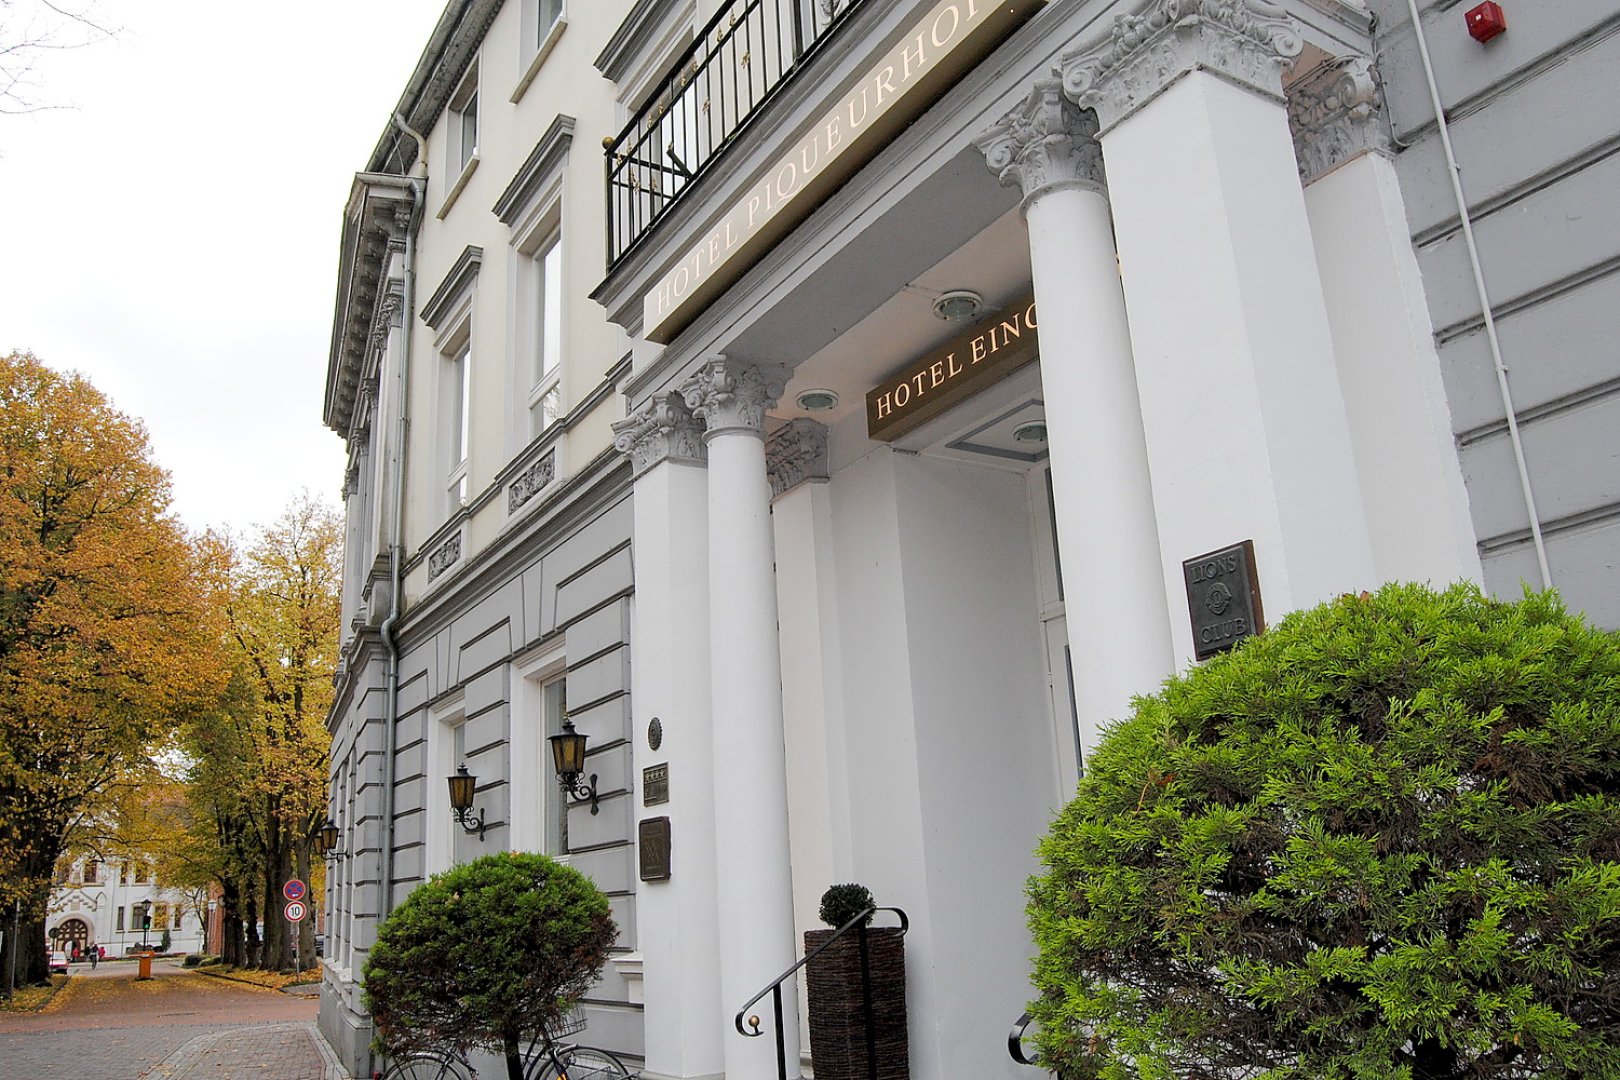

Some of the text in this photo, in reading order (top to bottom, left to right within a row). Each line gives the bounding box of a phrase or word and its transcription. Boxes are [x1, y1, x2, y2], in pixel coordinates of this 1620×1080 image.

[656, 220, 739, 316] HOTEL
[876, 352, 963, 420] HOTEL
[1190, 555, 1237, 584] LIONS
[1201, 617, 1247, 643] CLUB
[291, 906, 300, 916] 10
